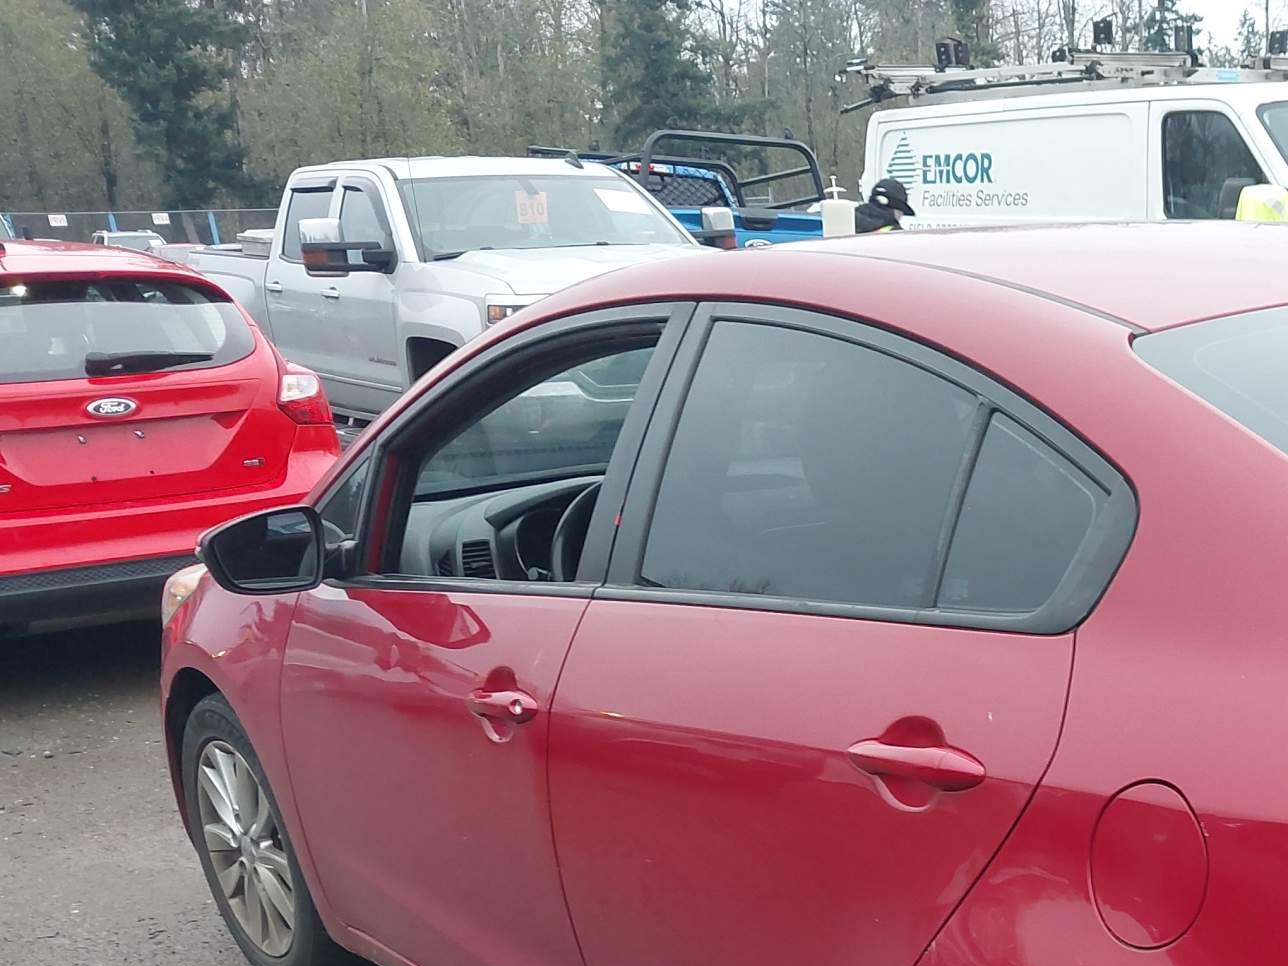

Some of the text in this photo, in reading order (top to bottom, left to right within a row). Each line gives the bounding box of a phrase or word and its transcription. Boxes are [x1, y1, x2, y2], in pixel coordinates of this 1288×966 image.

[922, 153, 993, 184] EMCOR
[922, 189, 1029, 208] Facilities Services
[99, 401, 125, 413] Ford
